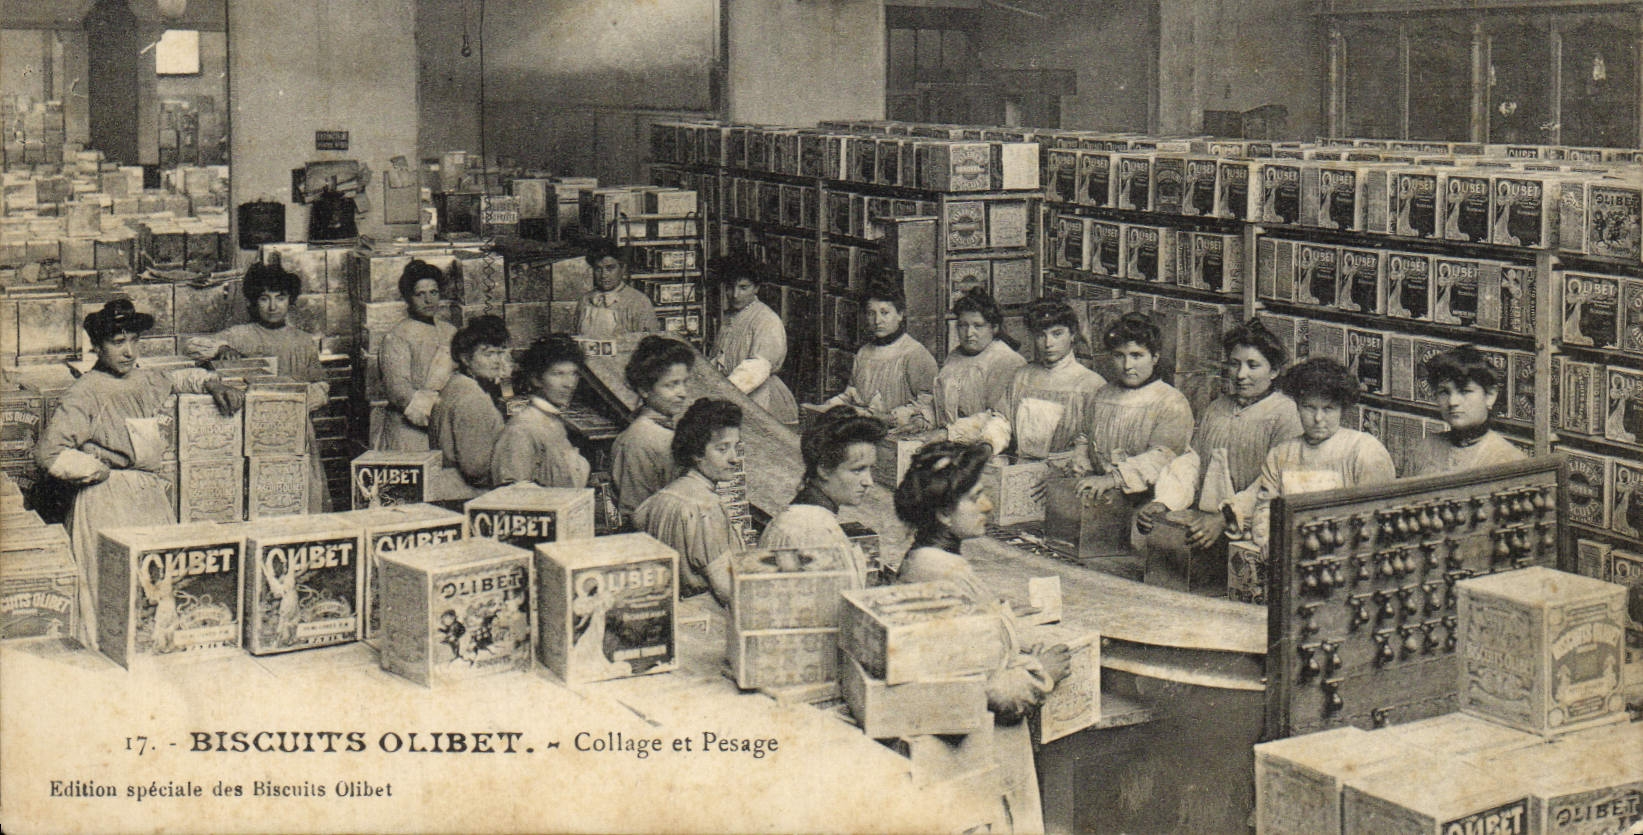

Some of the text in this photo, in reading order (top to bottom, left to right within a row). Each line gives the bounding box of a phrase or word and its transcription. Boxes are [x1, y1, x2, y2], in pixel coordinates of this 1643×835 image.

[1498, 181, 1540, 198] OLIBET
[1568, 279, 1616, 296] OLIBET
[358, 467, 420, 485] OLIBET
[474, 512, 552, 537] OLIBET
[141, 548, 234, 580] OLIBET
[264, 543, 352, 575] OLIBET
[441, 573, 523, 599] OLIBET
[574, 565, 672, 598] OLIBET
[1556, 796, 1641, 827] OLIBET
